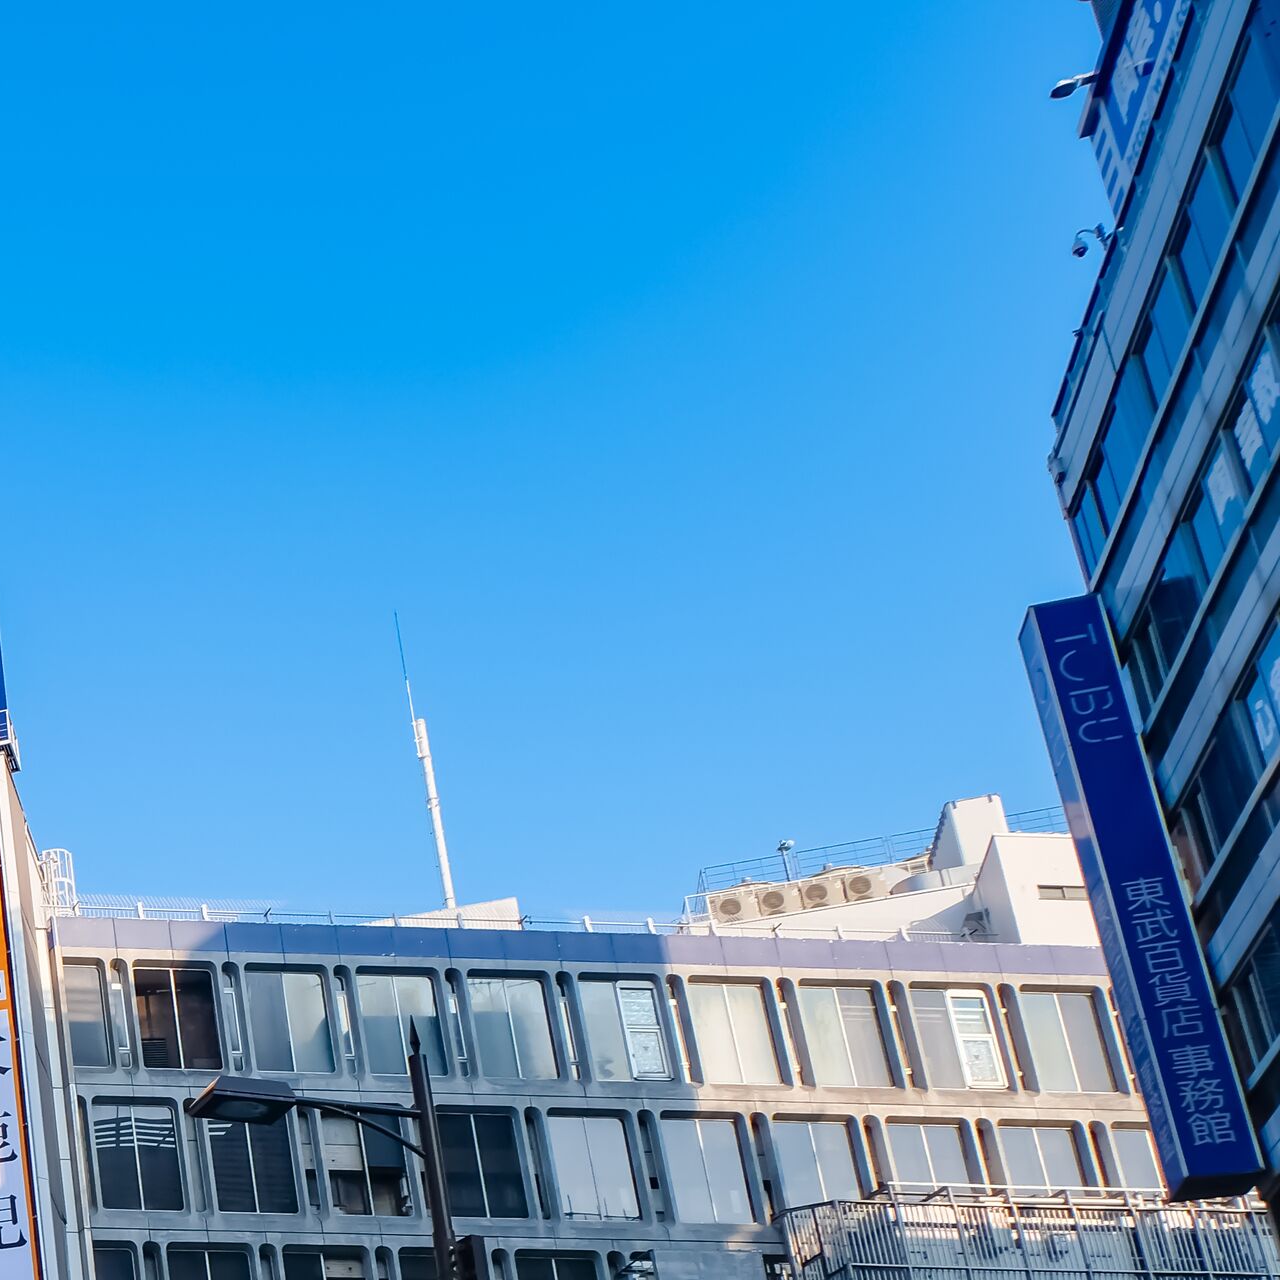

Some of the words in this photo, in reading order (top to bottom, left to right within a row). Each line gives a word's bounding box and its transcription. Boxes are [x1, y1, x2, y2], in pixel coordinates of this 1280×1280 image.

[1120, 876, 1207, 1038] 東武百貨店
[1167, 1044, 1237, 1146] 事務館
